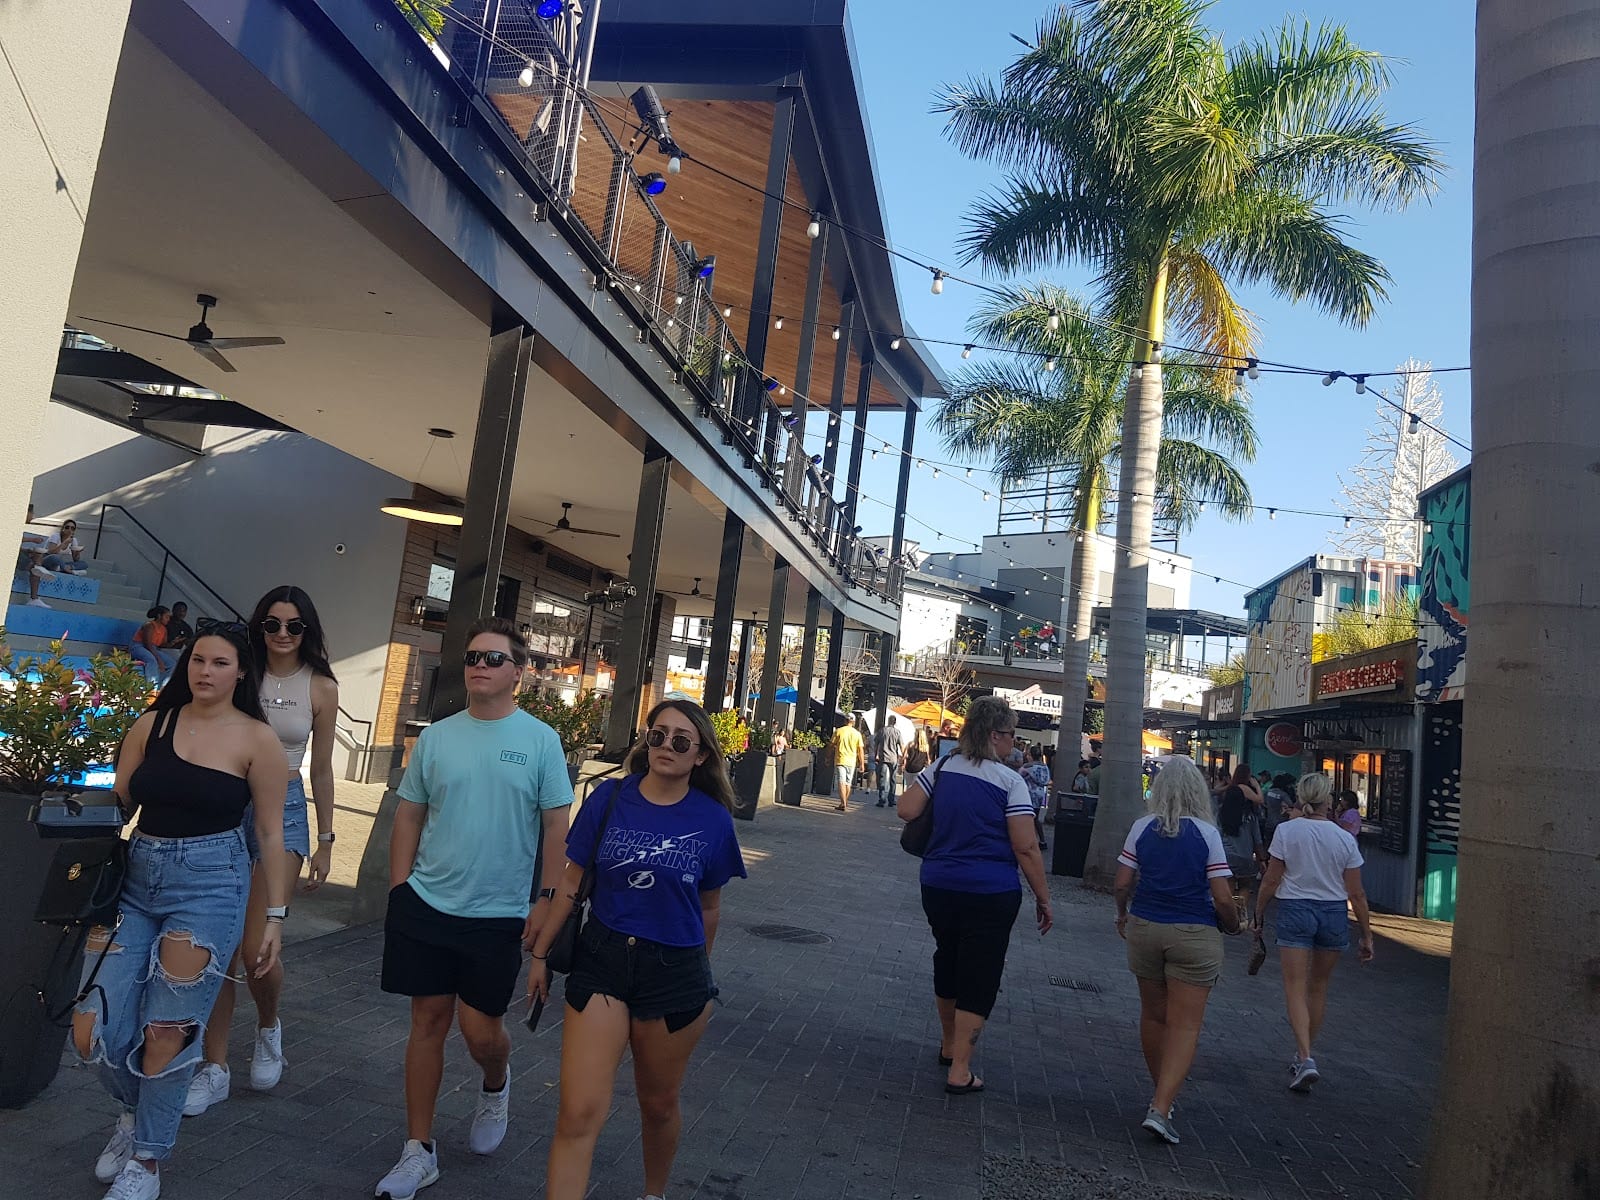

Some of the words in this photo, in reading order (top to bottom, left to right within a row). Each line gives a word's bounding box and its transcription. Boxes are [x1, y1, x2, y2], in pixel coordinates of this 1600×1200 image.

[502, 751, 525, 764] YETI
[606, 827, 665, 850] TAMPA
[668, 836, 708, 856] BAY
[600, 842, 701, 873] LIGHTNING
